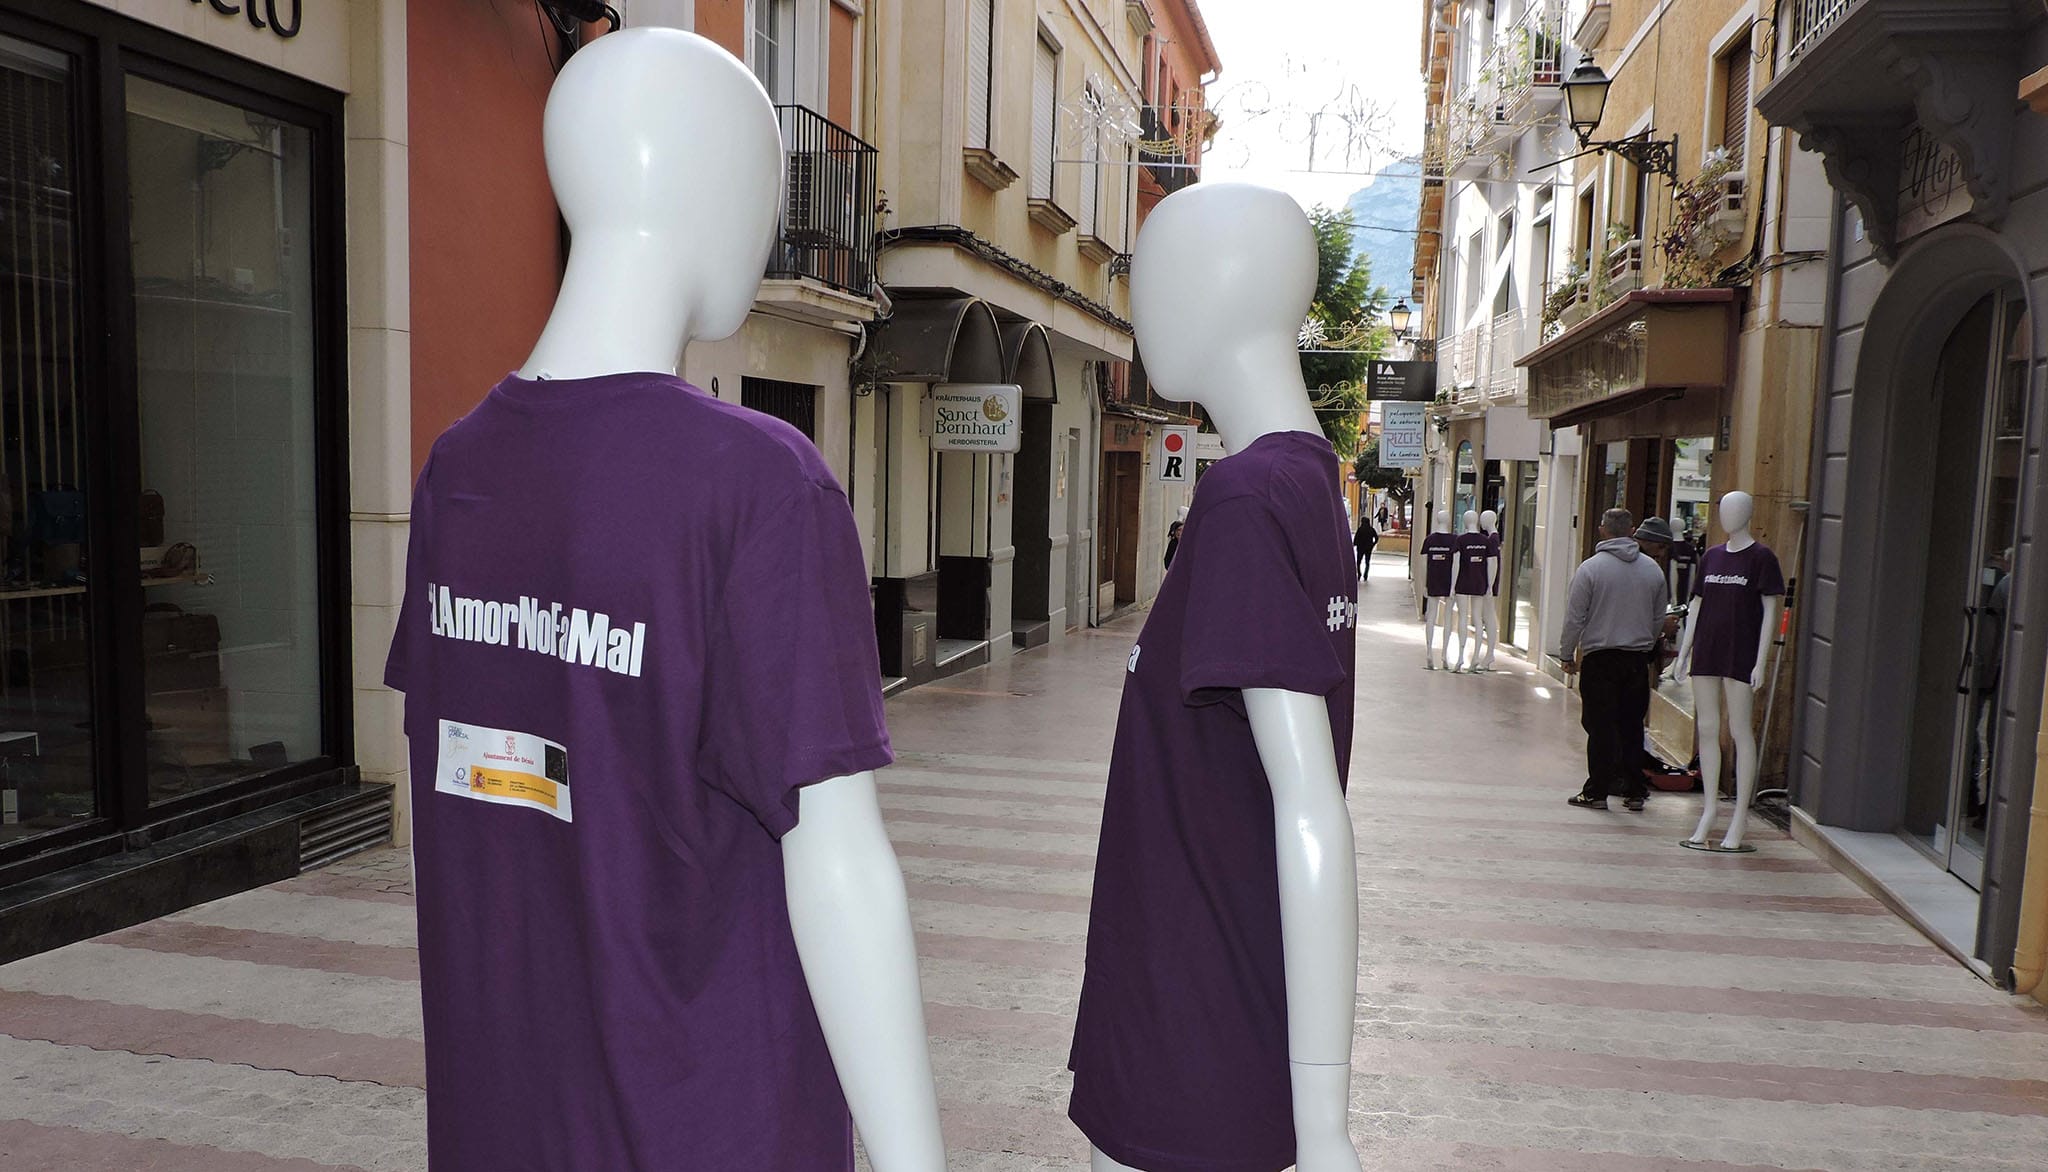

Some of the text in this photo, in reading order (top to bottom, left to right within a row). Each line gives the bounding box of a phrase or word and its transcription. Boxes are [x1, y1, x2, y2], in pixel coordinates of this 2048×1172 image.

[711, 376, 719, 398] 9
[937, 407, 979, 422] Sanct
[935, 420, 1006, 435] Bernhard
[1163, 456, 1183, 477] R
